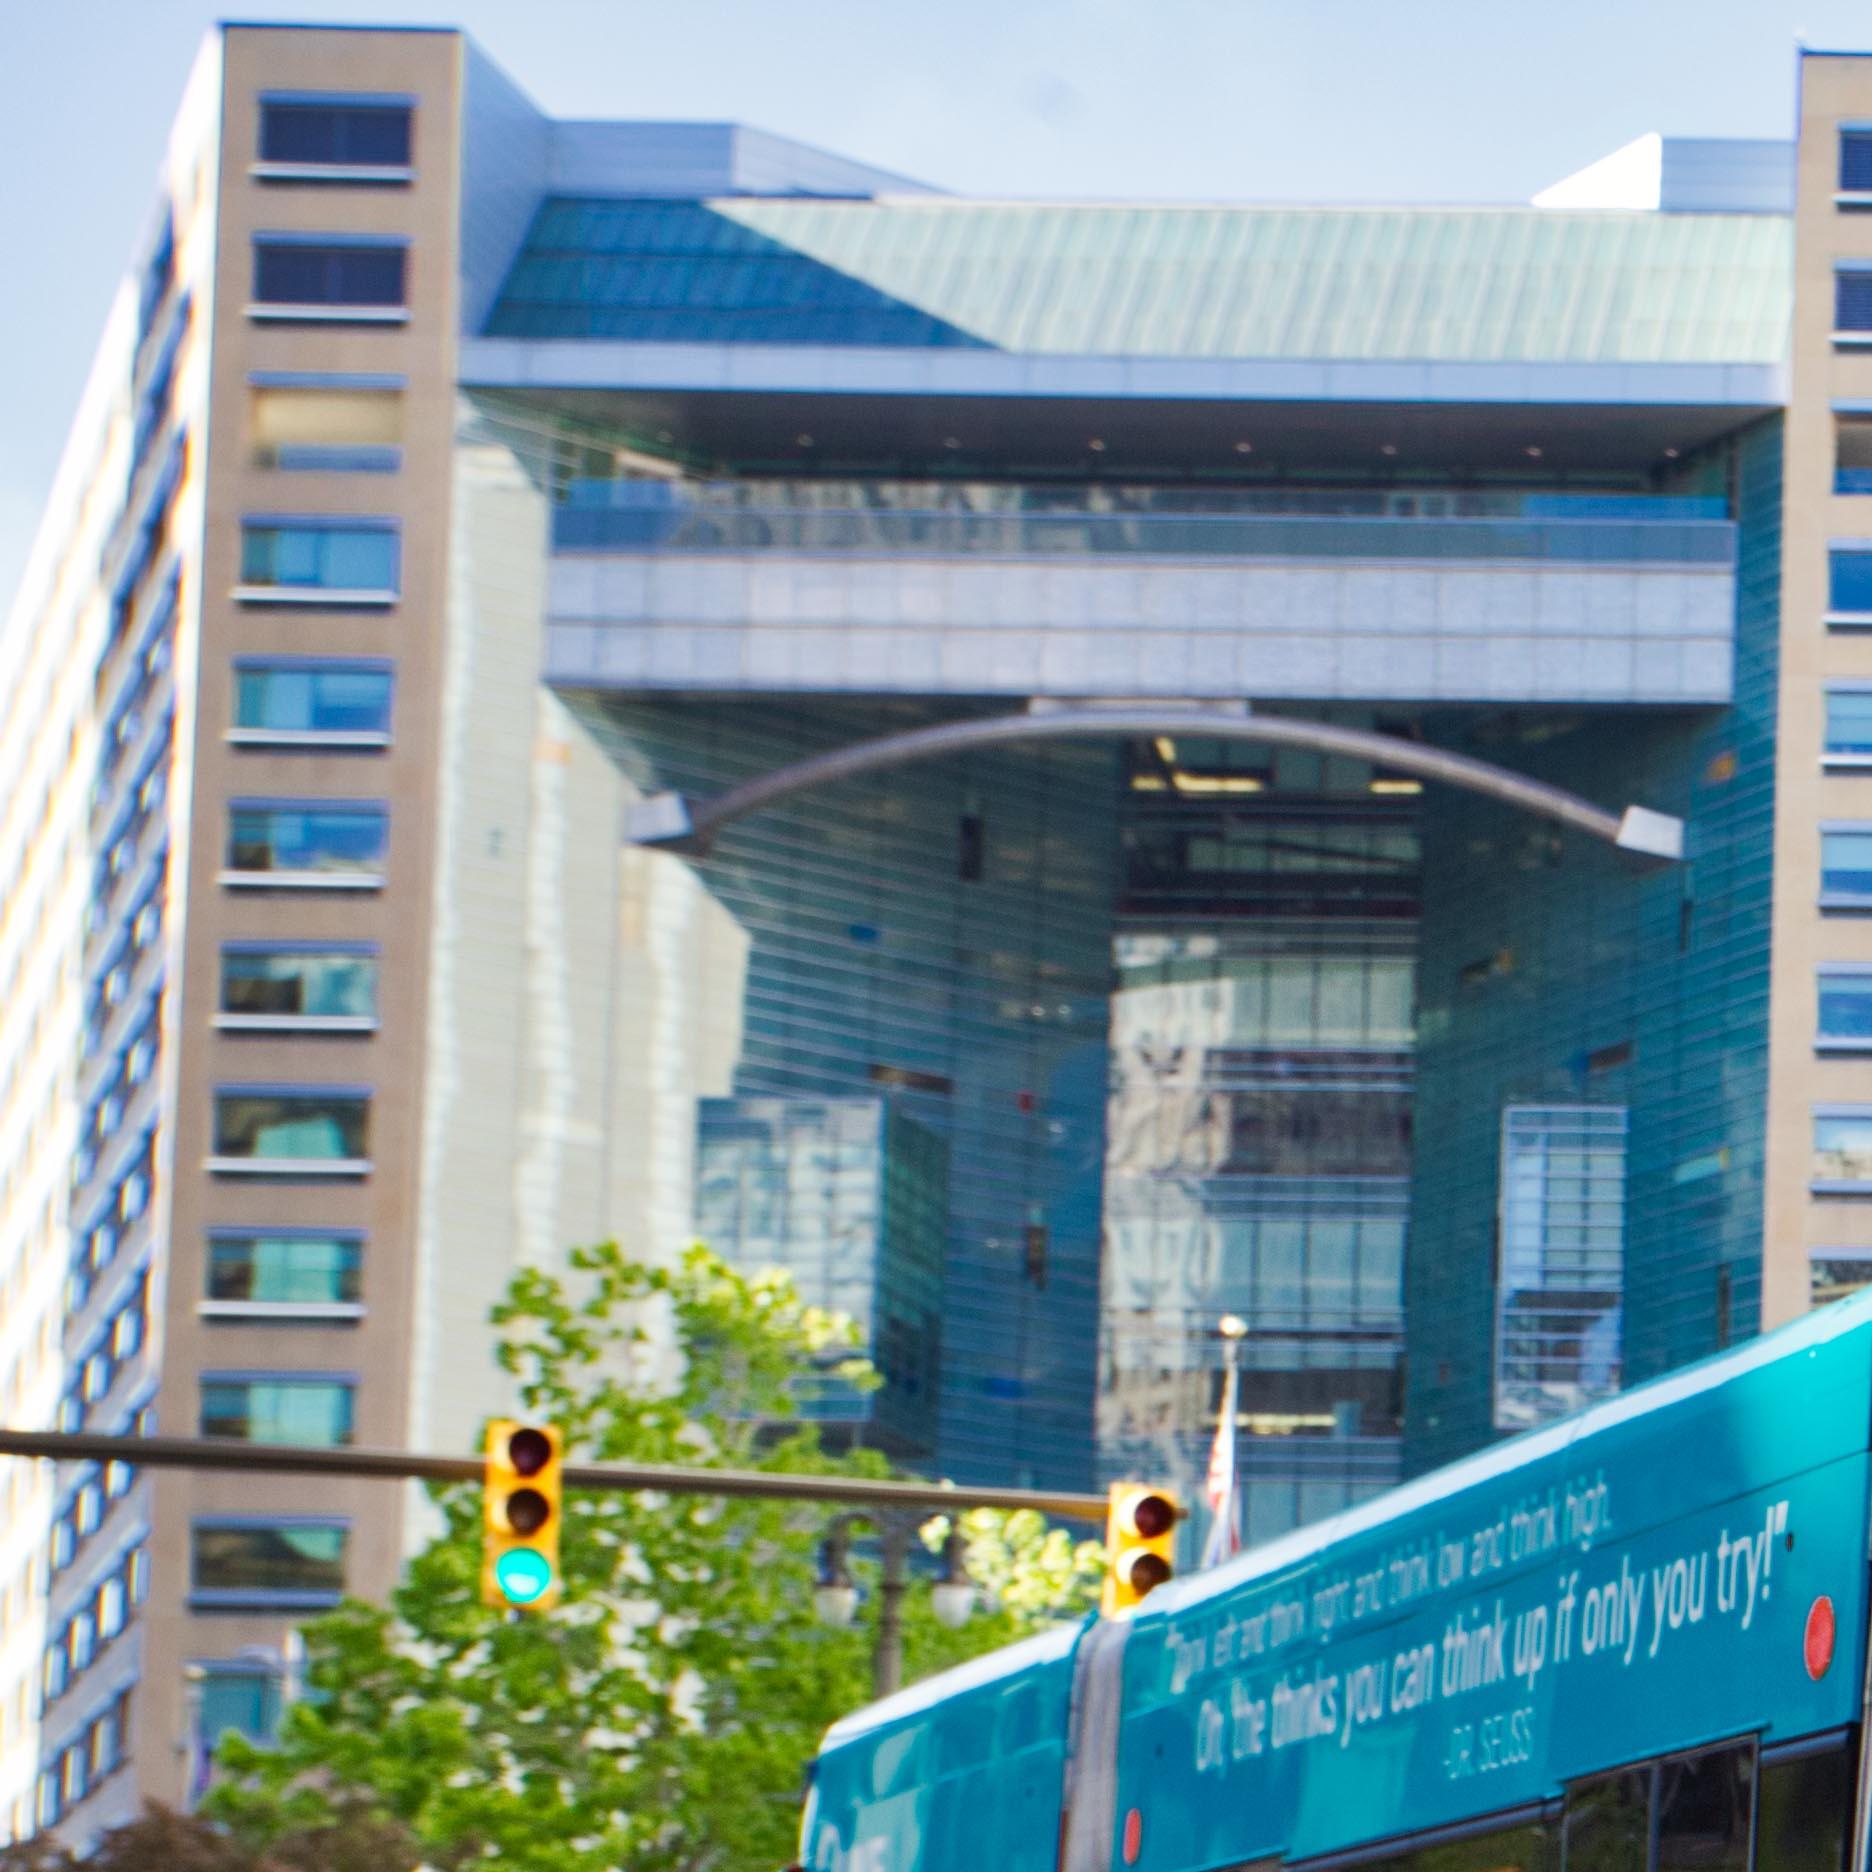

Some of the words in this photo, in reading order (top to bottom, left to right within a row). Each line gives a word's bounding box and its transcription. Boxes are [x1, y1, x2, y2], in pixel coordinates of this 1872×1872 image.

[1341, 1658, 1388, 1750] you
[1391, 1642, 1435, 1714] can
[1442, 1598, 1506, 1698] think
[1513, 1603, 1548, 1692] up
[1553, 1570, 1580, 1664] if
[1581, 1553, 1646, 1667] only
[1649, 1551, 1708, 1660] you
